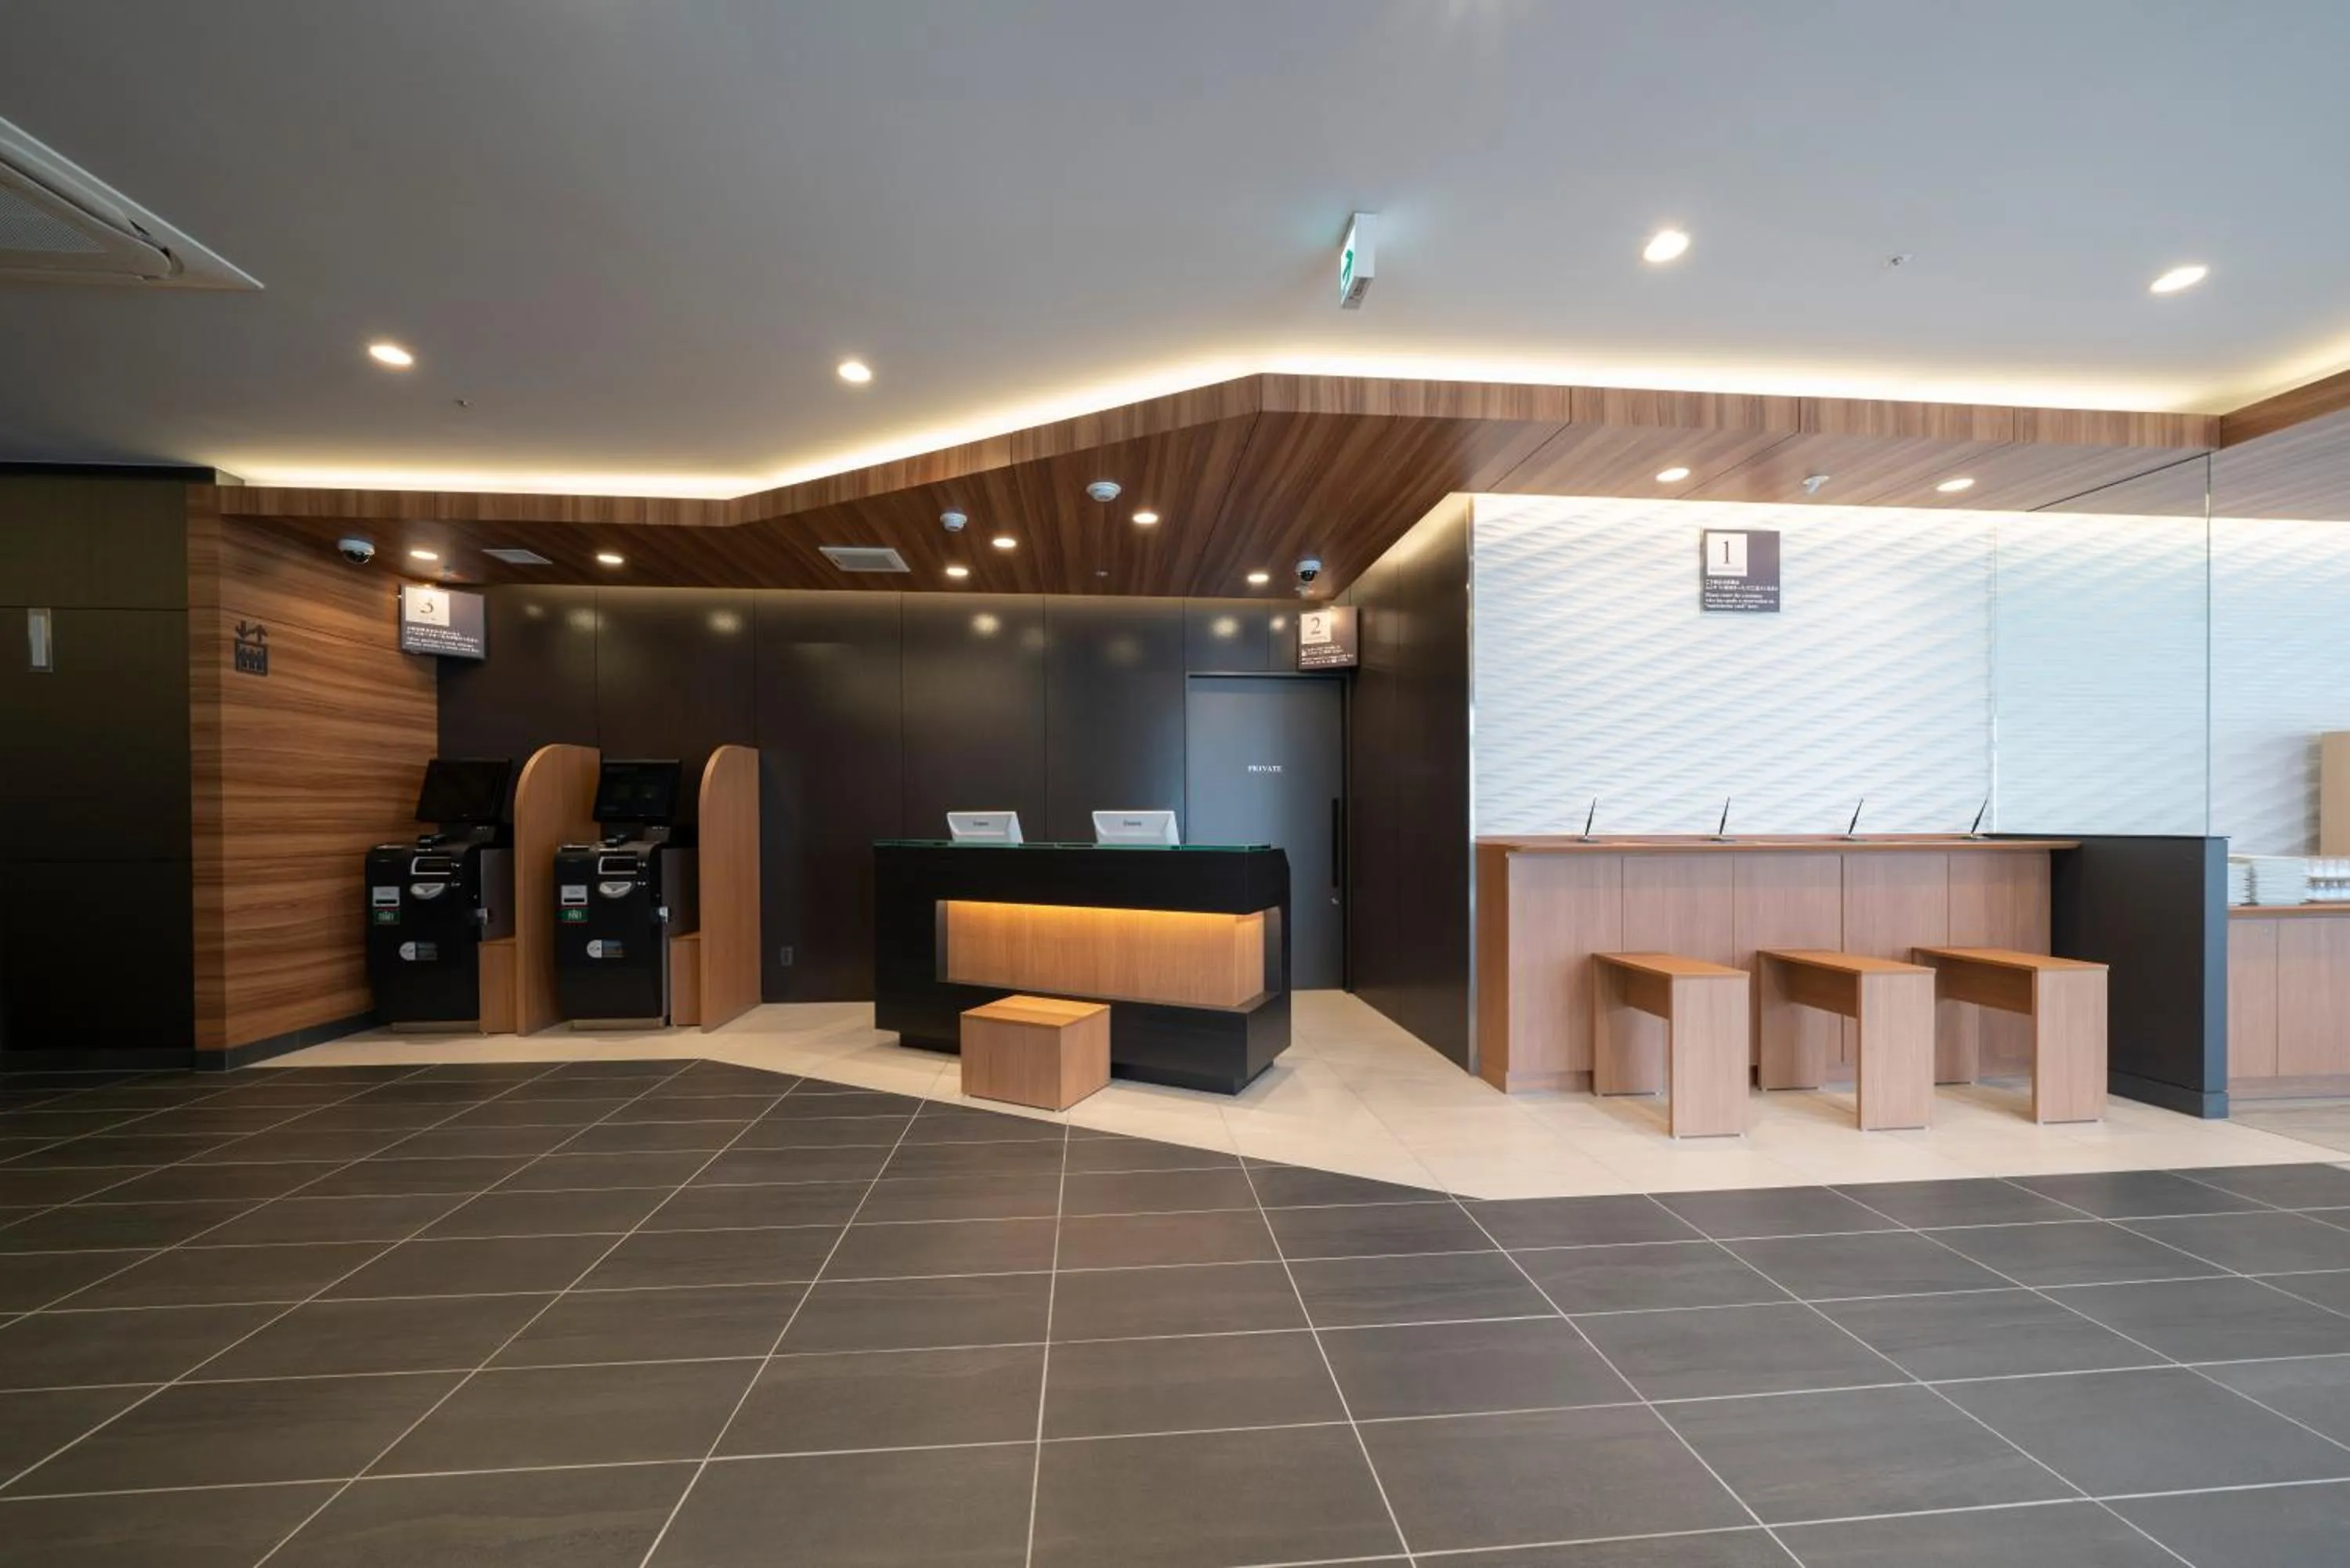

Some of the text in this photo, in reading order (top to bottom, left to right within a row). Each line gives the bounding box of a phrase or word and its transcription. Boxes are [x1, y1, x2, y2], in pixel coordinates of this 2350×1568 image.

[1722, 540, 1731, 565] 1
[1310, 616, 1321, 635] 2
[1248, 764, 1282, 773] PRIVATE
